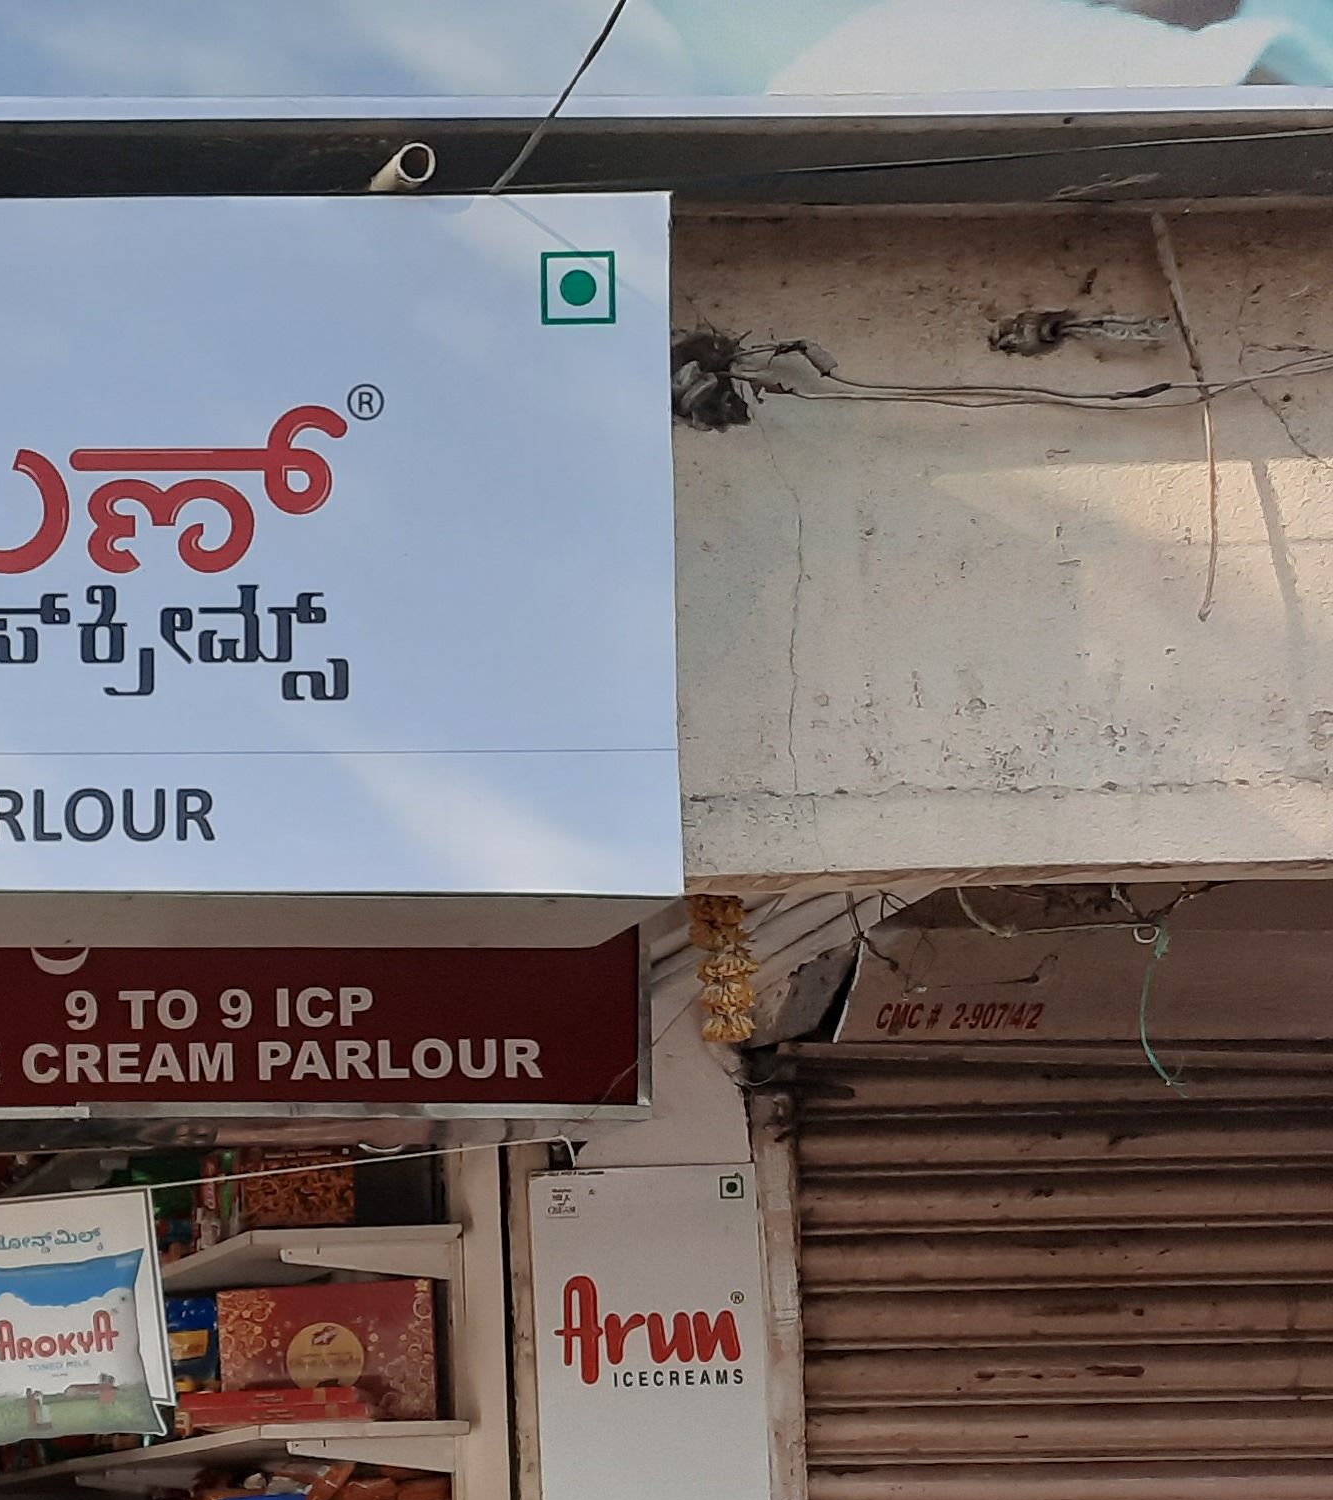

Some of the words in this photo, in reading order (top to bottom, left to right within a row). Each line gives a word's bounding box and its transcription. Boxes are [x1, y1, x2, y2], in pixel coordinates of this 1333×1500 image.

[65, 991, 99, 1031] 9
[119, 989, 197, 1031] TO
[218, 989, 254, 1030] 9
[274, 986, 374, 1028] ICP
[21, 1041, 236, 1084] CREAM
[257, 1037, 544, 1081] PARLOUR
[554, 1275, 742, 1386] Arun
[613, 1369, 745, 1388] ICECREAMS
